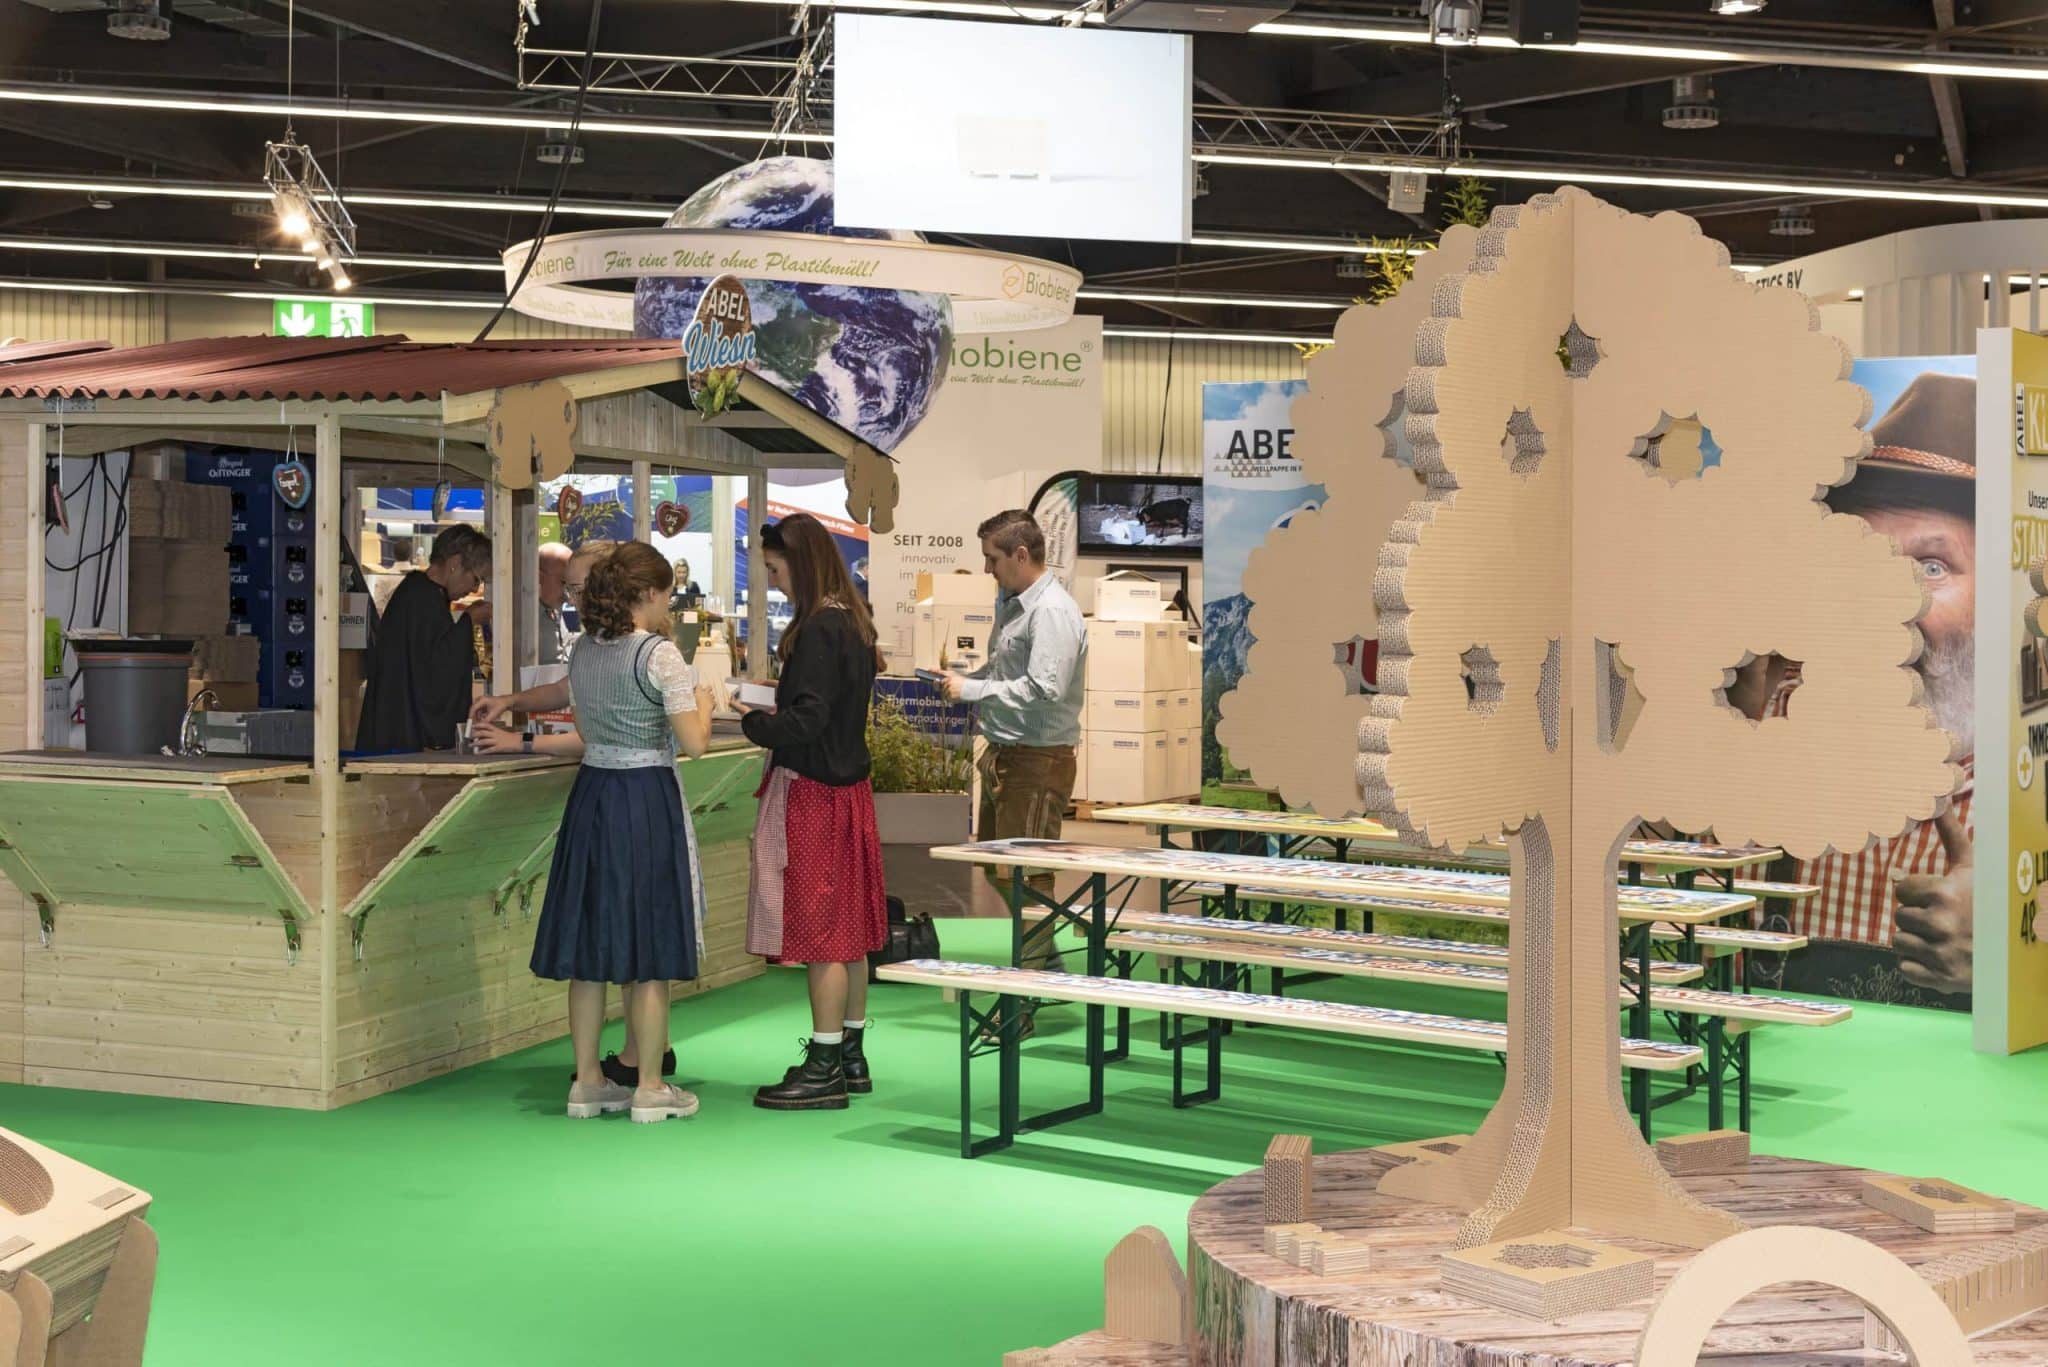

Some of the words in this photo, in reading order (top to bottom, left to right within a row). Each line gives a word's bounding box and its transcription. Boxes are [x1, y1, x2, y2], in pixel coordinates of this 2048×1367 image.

[604, 250, 632, 273] Für
[638, 253, 668, 268] eine
[673, 249, 715, 268] Welt
[720, 249, 758, 269] ohne
[765, 251, 880, 277] Plastikmüll!
[1026, 271, 1071, 304] Biobiene
[1787, 269, 1803, 289] BV
[705, 288, 746, 322] ABEL
[683, 318, 757, 374] Wiesn
[951, 336, 1093, 372] iobiene®
[2016, 388, 2024, 449] ABEL
[1226, 428, 1295, 460] ABE
[893, 534, 923, 547] SEIT
[928, 535, 964, 548] 2008
[901, 552, 957, 565] innovativ
[899, 569, 914, 580] im
[896, 602, 915, 614] Pla
